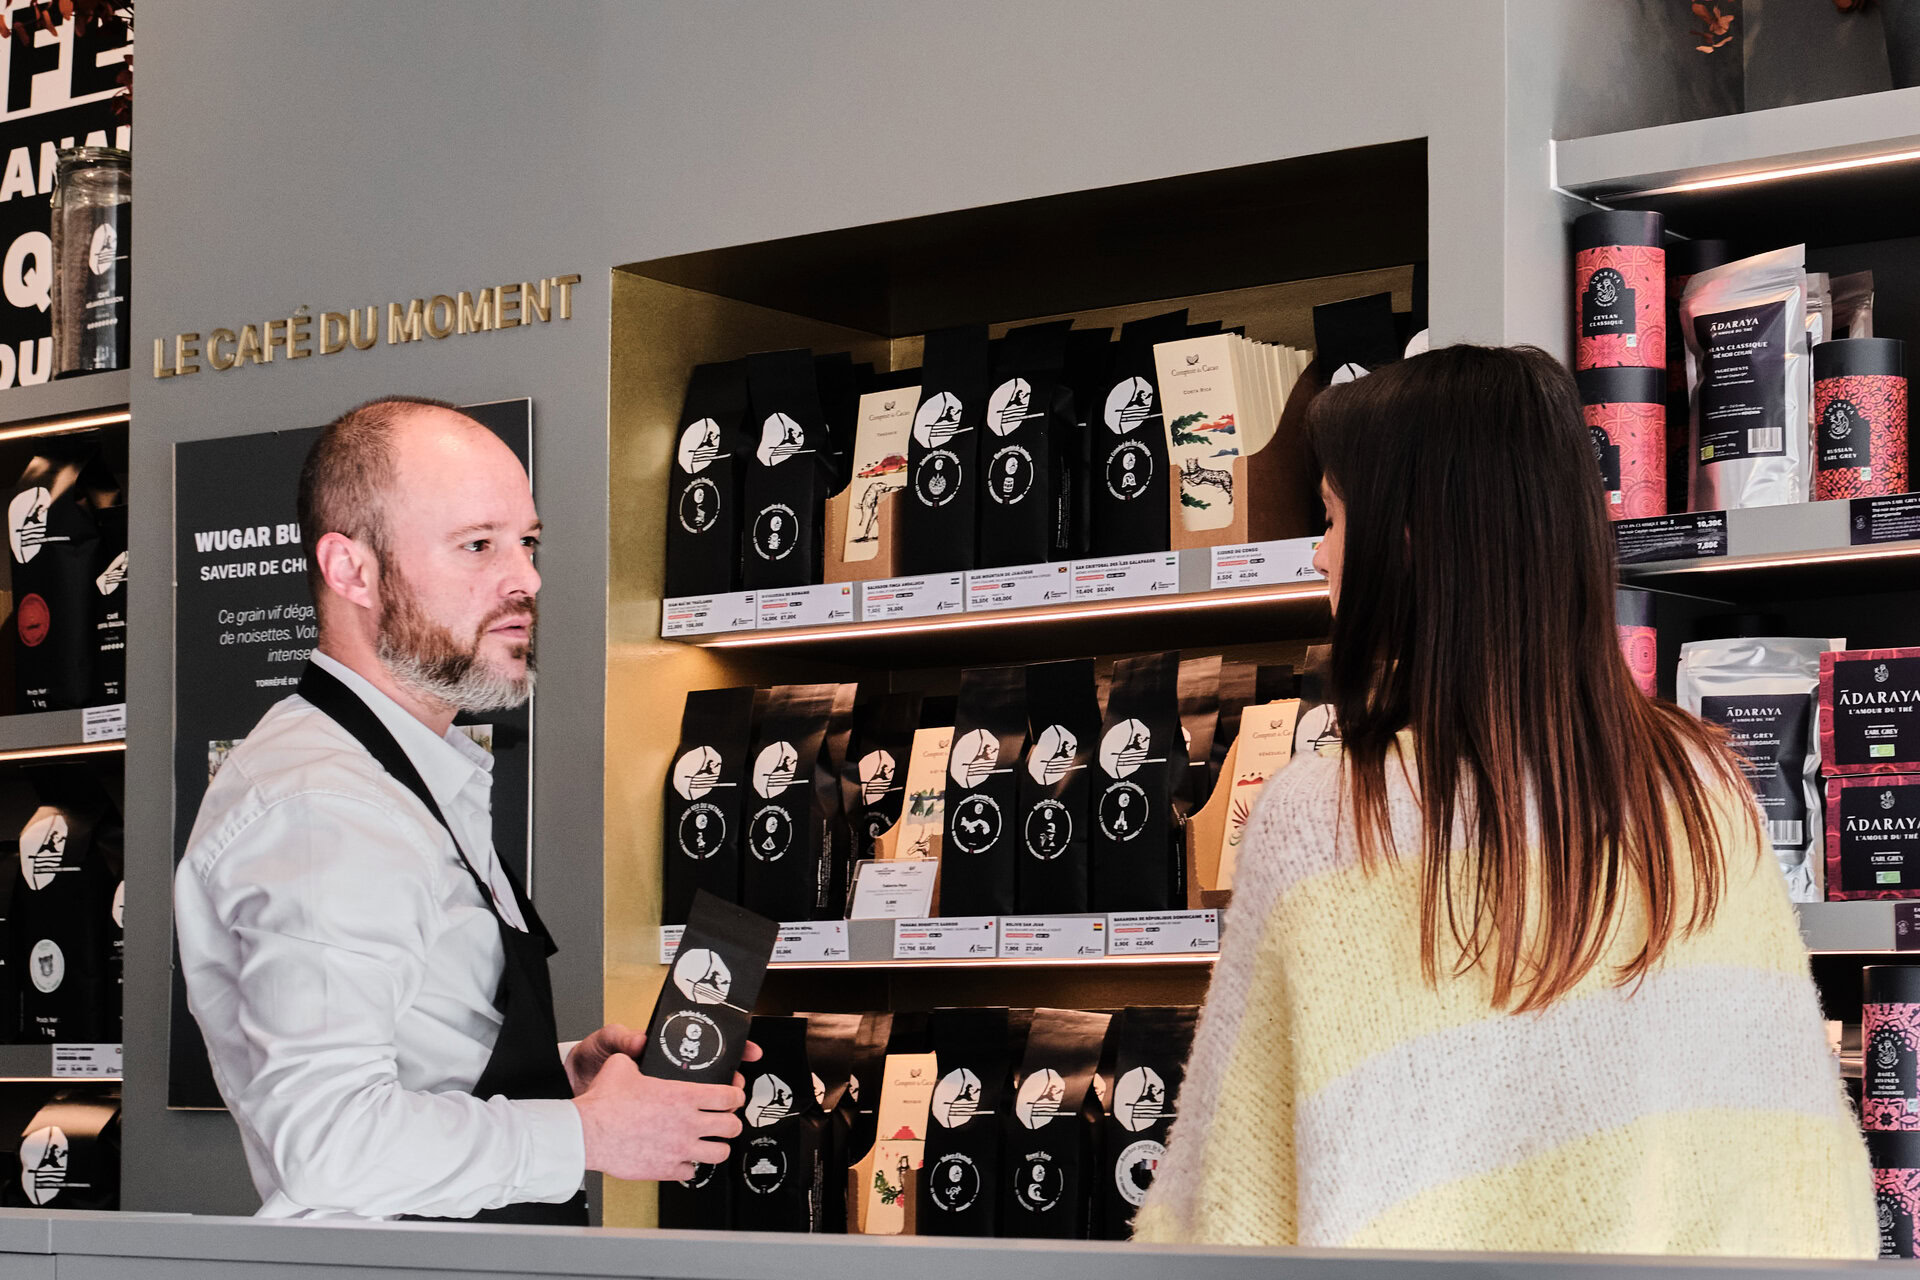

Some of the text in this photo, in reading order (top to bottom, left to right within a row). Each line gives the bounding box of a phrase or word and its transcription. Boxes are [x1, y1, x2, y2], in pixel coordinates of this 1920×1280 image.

[153, 273, 581, 379] LE CAFÉ DU MOMENT
[1589, 319, 1624, 327] CLASSIQUE
[1726, 341, 1768, 351] CLASSIQUE
[194, 525, 271, 553] WUGAR
[200, 562, 257, 581] SAVEUR
[259, 560, 279, 576] DE
[218, 603, 316, 626] Ce grain vif déga
[219, 631, 234, 645] de
[237, 628, 292, 643] noisettes.
[1726, 706, 1782, 717] ĀDARAYA
[1848, 705, 1913, 715] L'AMOUR DU THÉ
[1904, 832, 1918, 840] THÉ
